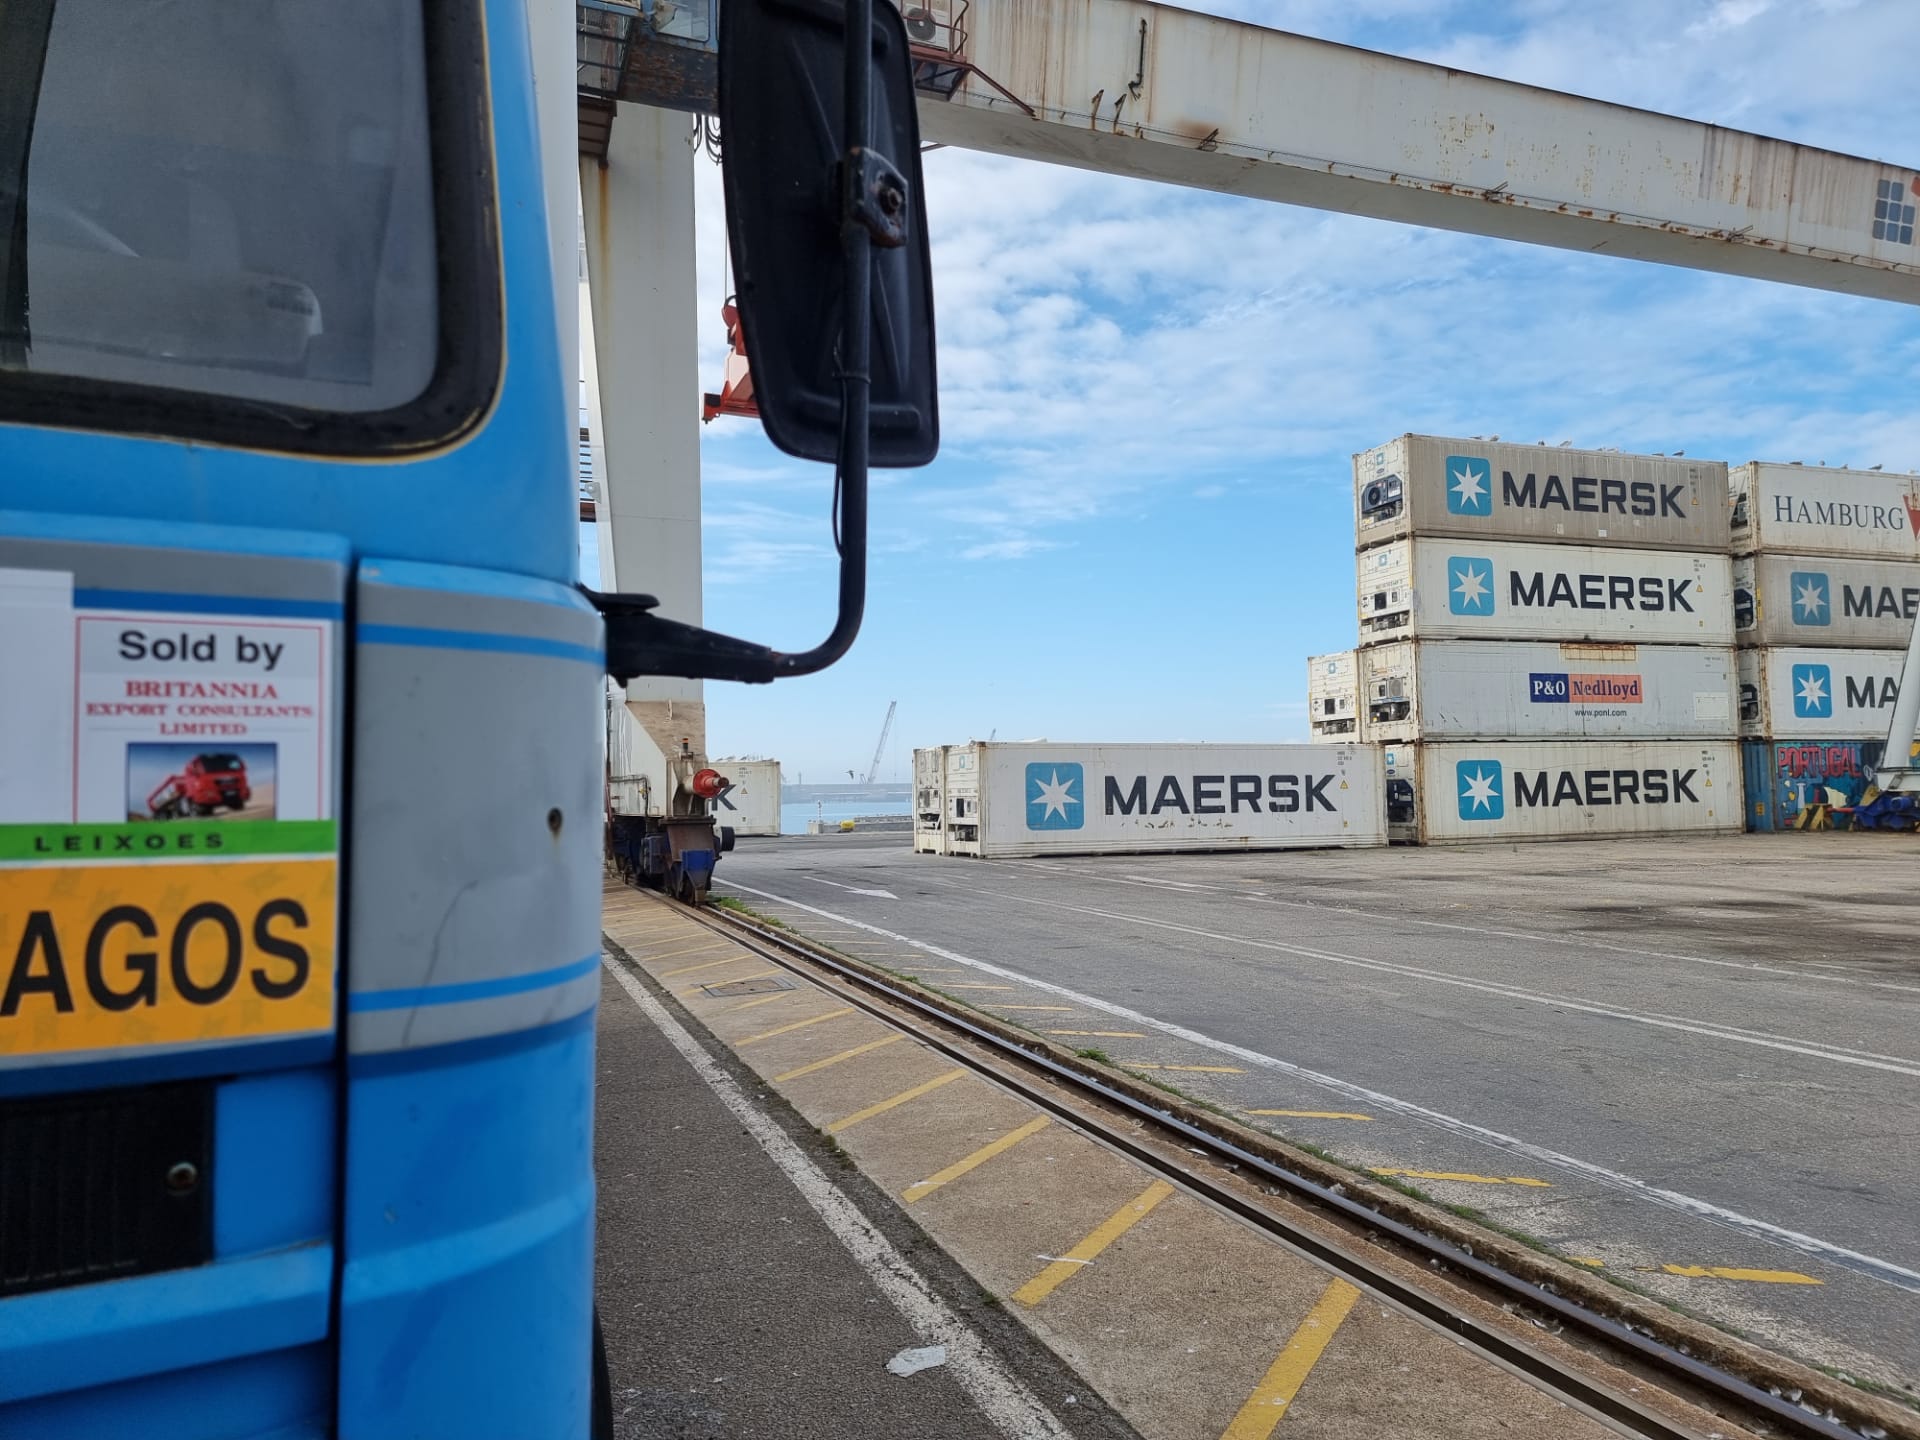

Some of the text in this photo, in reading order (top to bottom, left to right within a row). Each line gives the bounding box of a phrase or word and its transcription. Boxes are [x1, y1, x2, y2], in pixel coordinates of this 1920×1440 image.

[1502, 471, 1687, 519] MAERSK
[1774, 495, 1904, 530] HAMBURG
[1510, 570, 1695, 613] MAERSK
[118, 630, 284, 671] Sold by
[124, 680, 278, 699] BRITANNIA
[1573, 680, 1640, 700] Nedlloyd
[85, 703, 313, 718] EXPORT CONSULTANTS
[159, 723, 247, 735] LIMITED
[1777, 746, 1862, 778] PORTUGAL
[1104, 774, 1338, 816] MAERSK
[1514, 768, 1700, 808] MAERSK
[34, 831, 225, 853] LEIXOES
[0, 898, 310, 1017] AGOS
